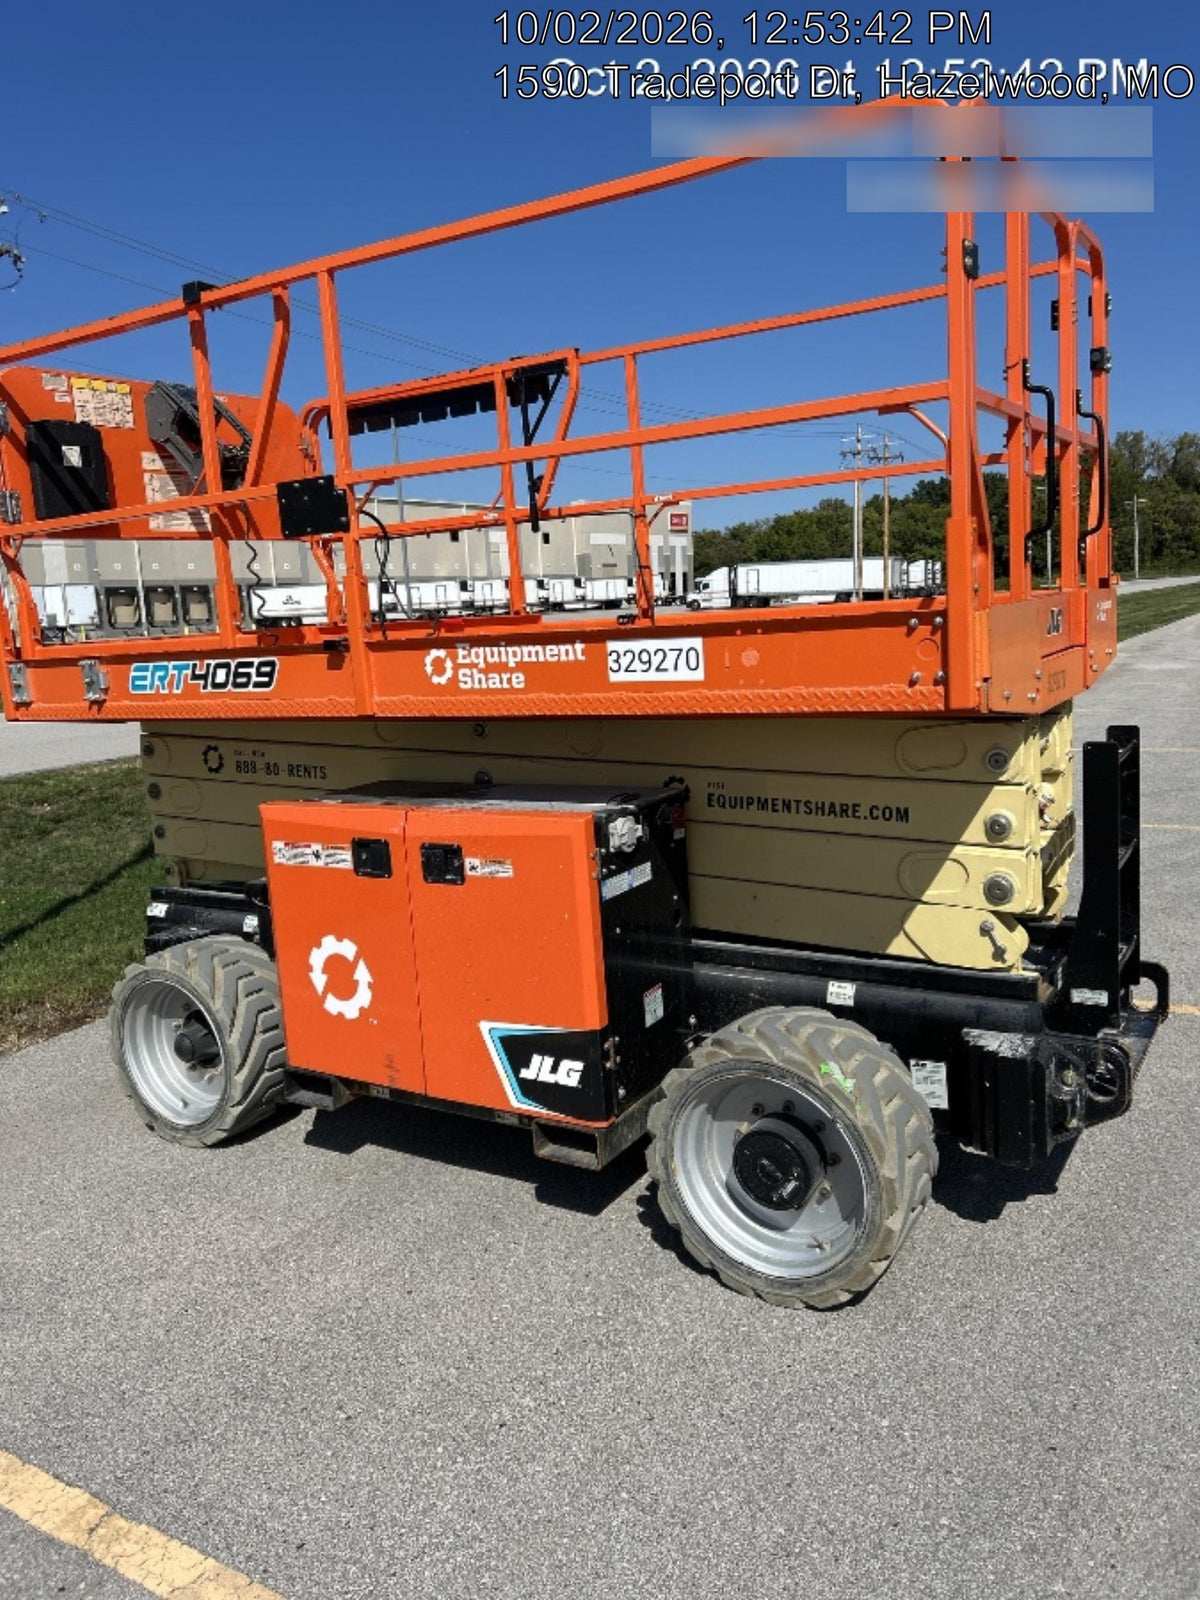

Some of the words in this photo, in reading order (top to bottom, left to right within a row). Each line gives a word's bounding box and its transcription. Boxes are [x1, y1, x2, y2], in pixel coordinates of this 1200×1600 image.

[456, 640, 586, 668] Equipment
[608, 647, 700, 673] 329270
[130, 658, 279, 693] ERT4069
[458, 668, 525, 690] Share
[706, 792, 910, 823] EQUIPMENTSHARE.COM
[519, 1053, 585, 1087] JLG
